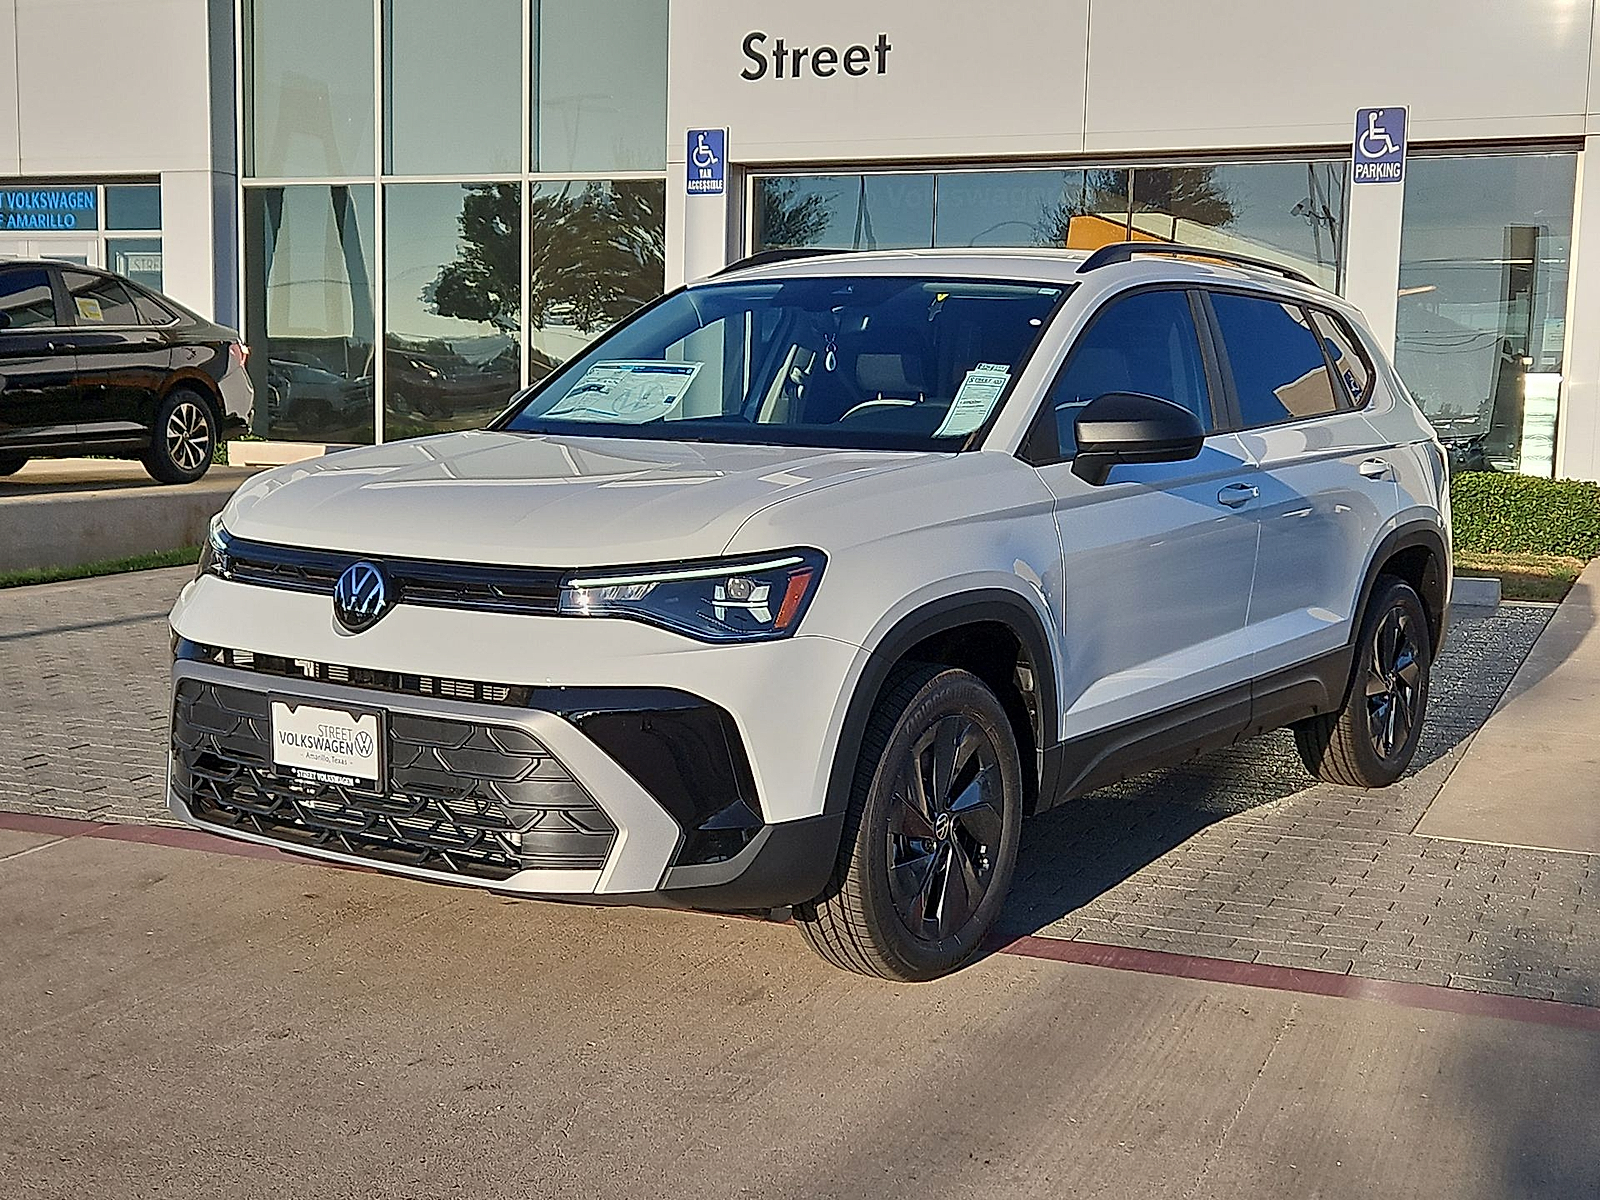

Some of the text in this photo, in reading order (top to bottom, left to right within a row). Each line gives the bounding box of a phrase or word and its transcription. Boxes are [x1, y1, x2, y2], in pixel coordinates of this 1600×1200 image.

[740, 31, 892, 81] Street
[1355, 162, 1401, 179] PARKING
[687, 179, 723, 190] ACCESSIBLE
[6, 190, 94, 209] VOLKSWAGEN
[7, 213, 76, 227] AMARILLO
[317, 724, 353, 741] STREET
[278, 730, 354, 755] VOLKSWAGEN
